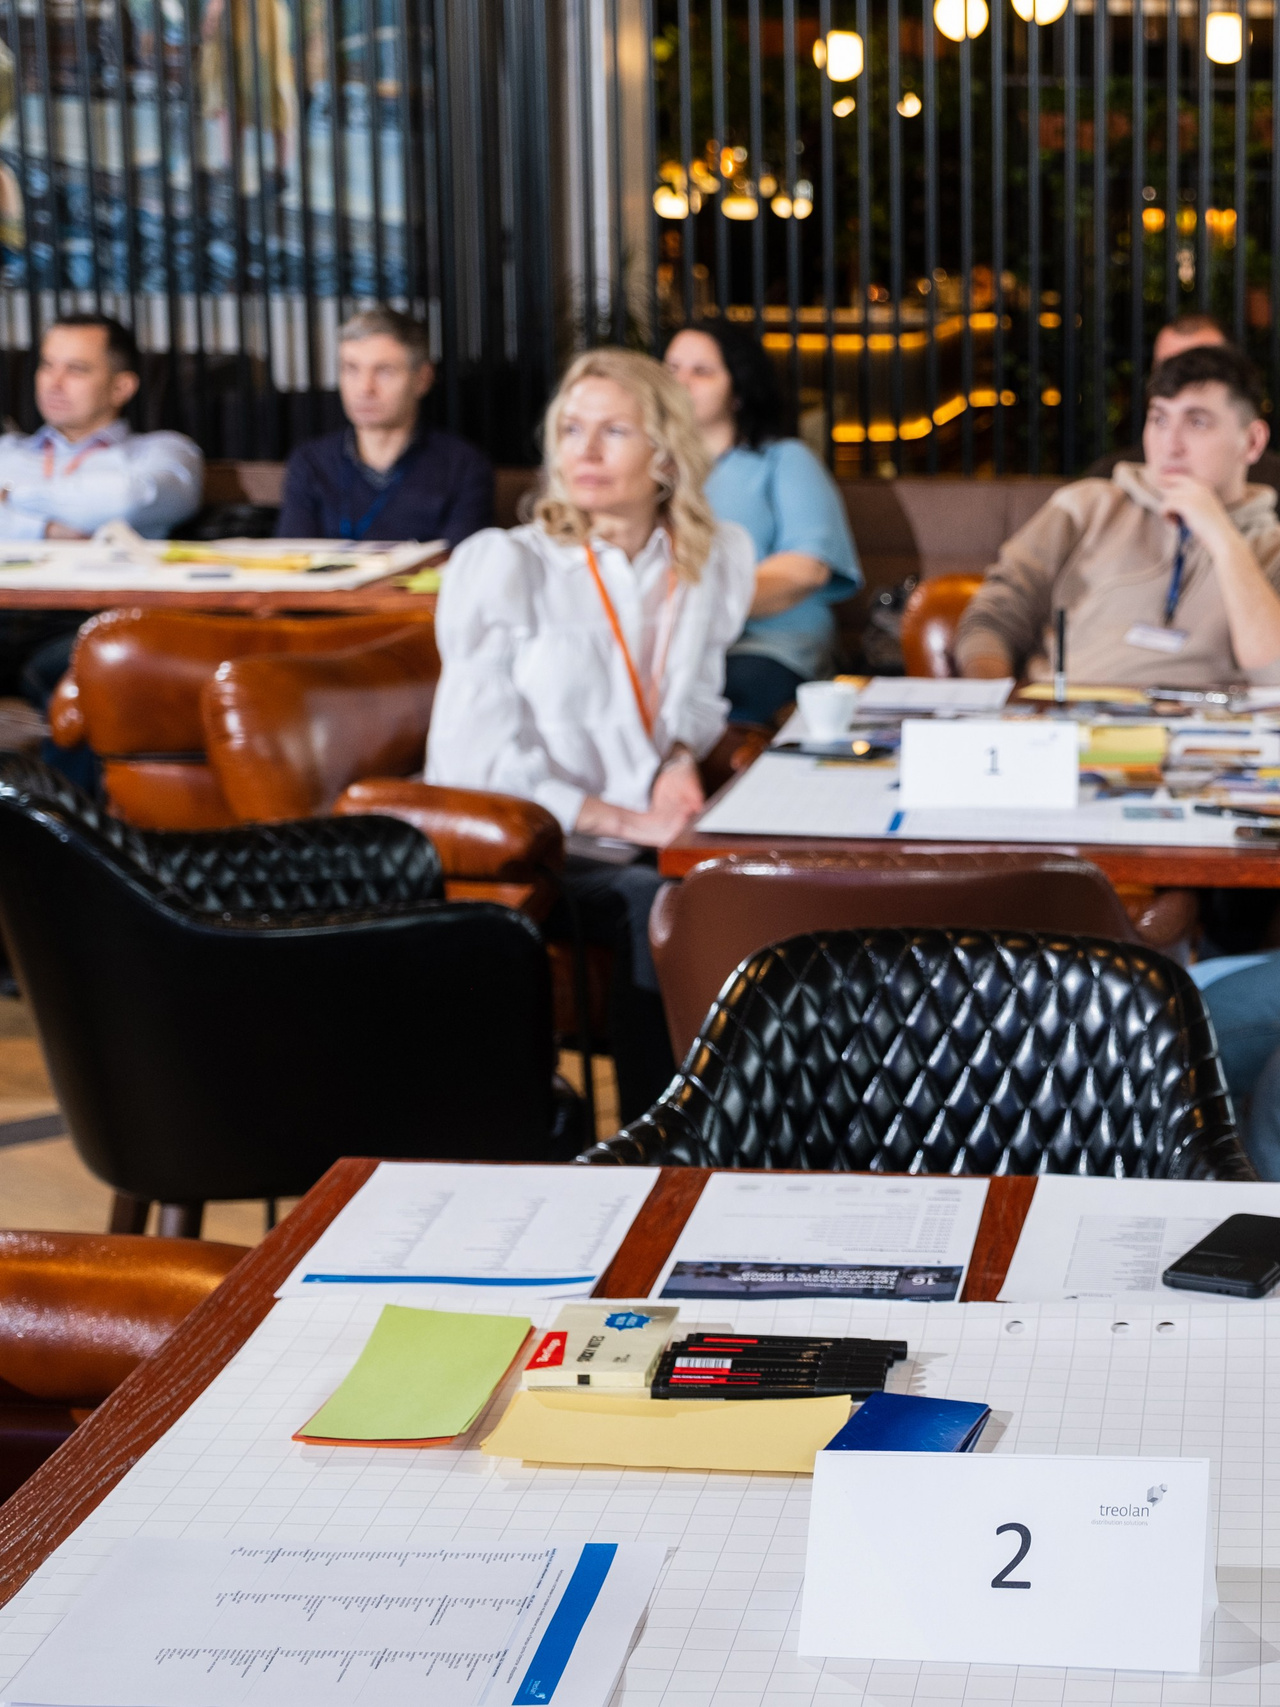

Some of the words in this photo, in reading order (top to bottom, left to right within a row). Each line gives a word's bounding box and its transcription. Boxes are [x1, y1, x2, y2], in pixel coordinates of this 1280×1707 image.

[984, 746, 1003, 777] 1
[1099, 1503, 1150, 1518] treolan
[1123, 1519, 1149, 1527] solutions
[991, 1522, 1032, 1590] 2
